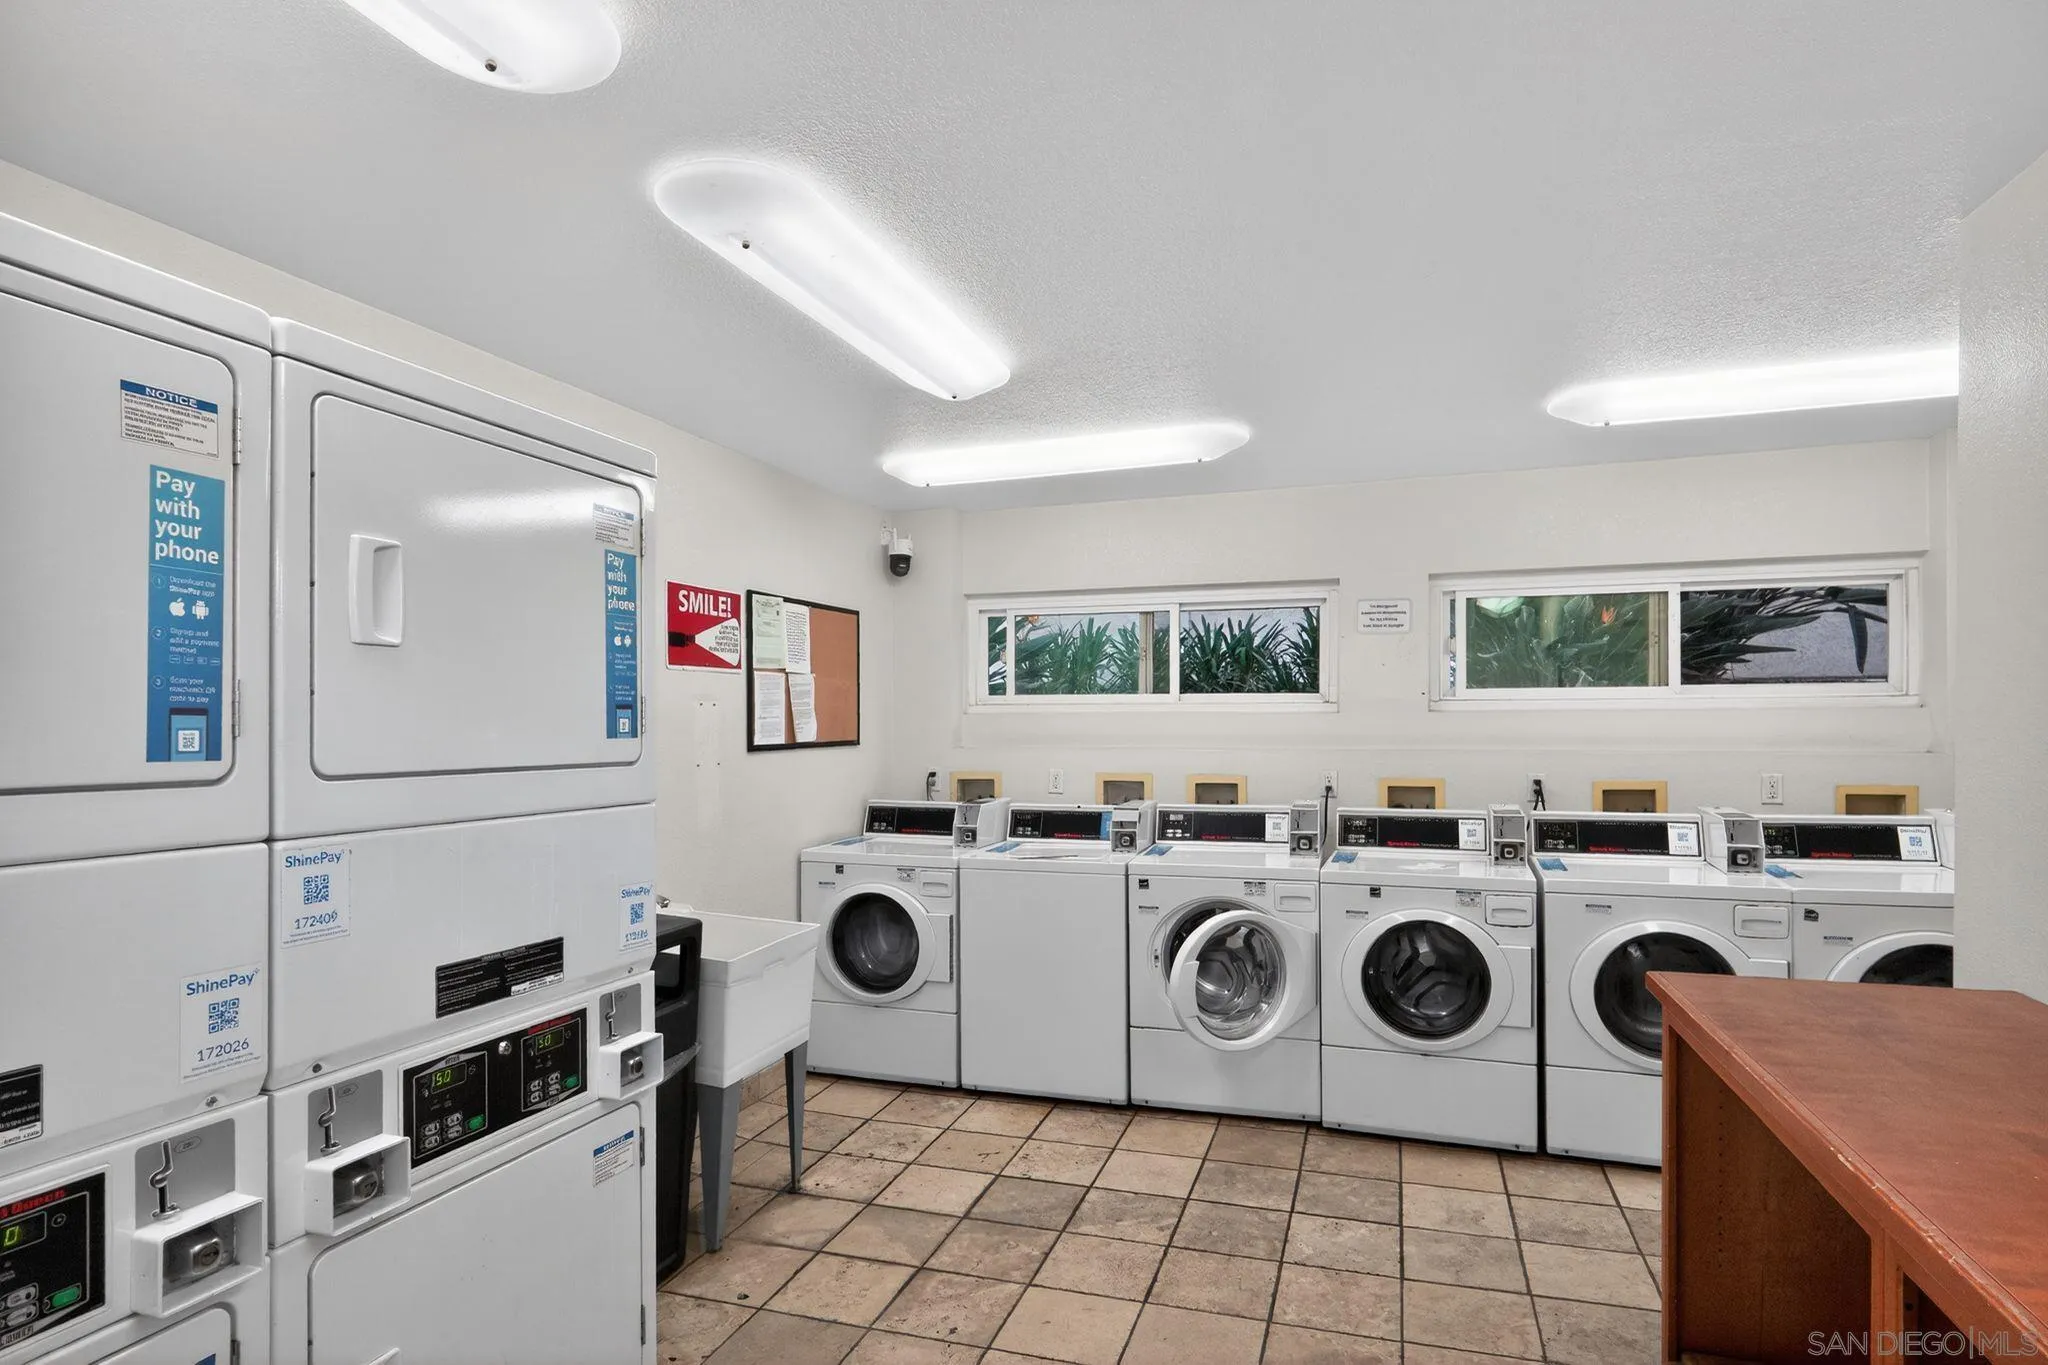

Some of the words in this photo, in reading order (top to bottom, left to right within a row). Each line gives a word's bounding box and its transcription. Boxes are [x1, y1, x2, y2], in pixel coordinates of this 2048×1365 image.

[145, 386, 198, 408] NOTICE
[156, 470, 195, 498] Pay
[155, 497, 200, 520] with
[155, 518, 202, 540] your
[155, 540, 219, 565] phone
[607, 553, 625, 570] Pay
[607, 583, 628, 597] your
[607, 595, 636, 611] phone
[678, 589, 732, 618] SMILE!
[285, 851, 342, 868] ShinePay
[186, 972, 255, 996] ShinePay
[197, 1038, 250, 1062] 172026
